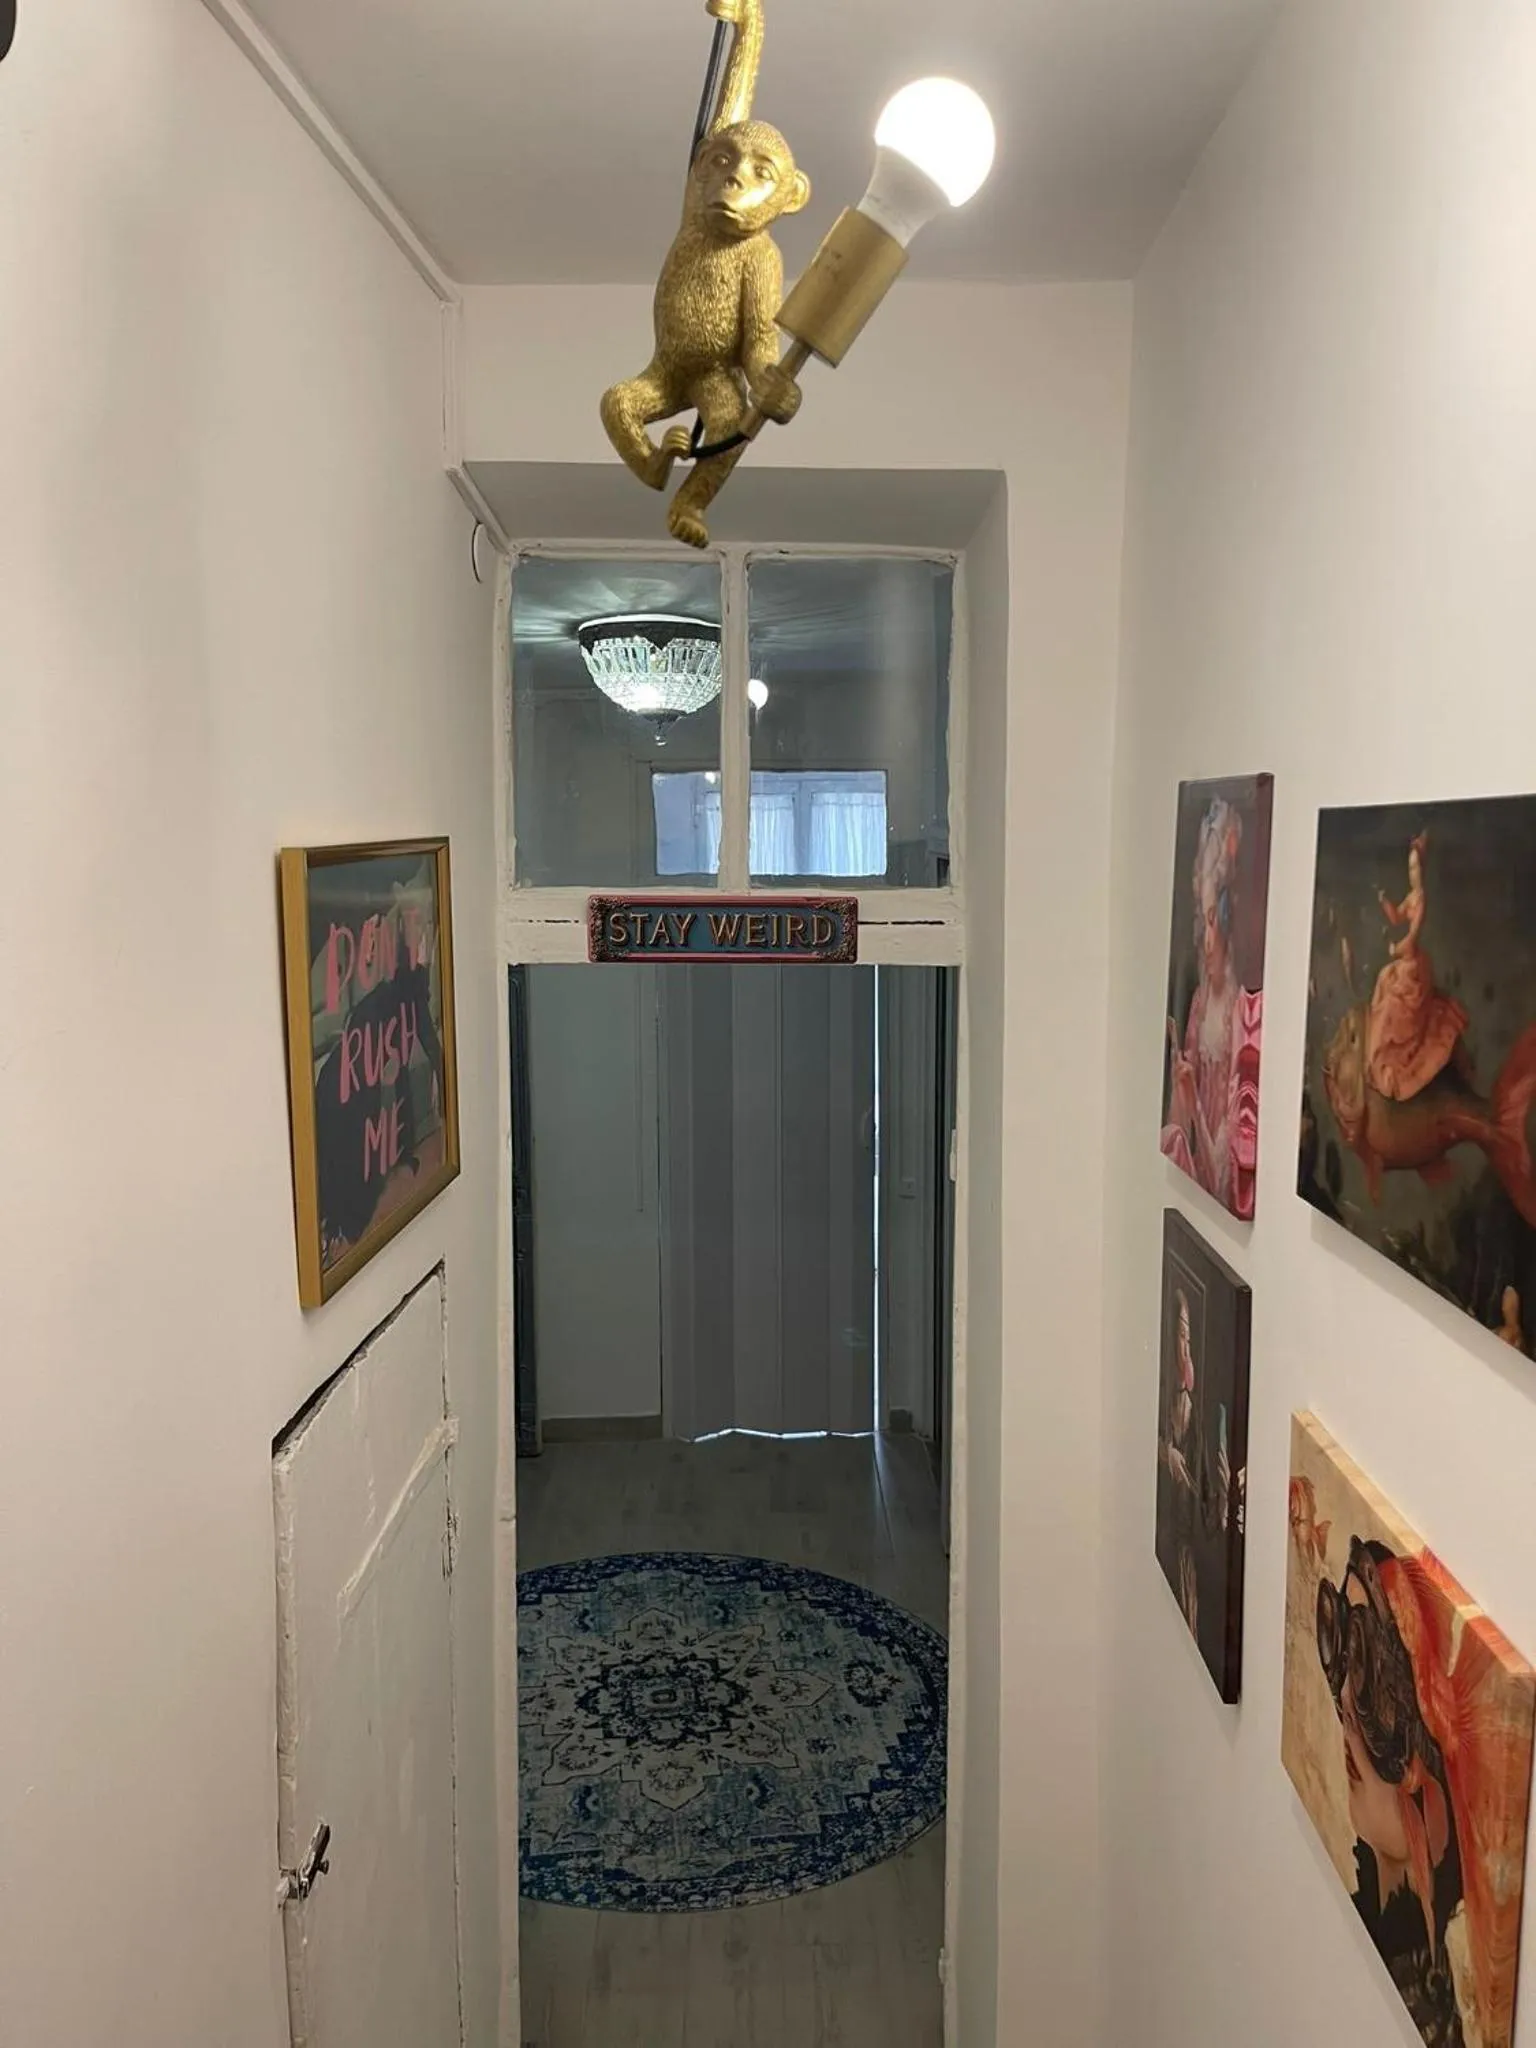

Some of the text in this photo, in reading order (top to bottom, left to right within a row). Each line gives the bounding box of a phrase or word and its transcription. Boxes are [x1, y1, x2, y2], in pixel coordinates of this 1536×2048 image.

[609, 912, 834, 947] STAY WEIRD
[339, 1001, 417, 1104] RUSH
[363, 1097, 405, 1182] ME
